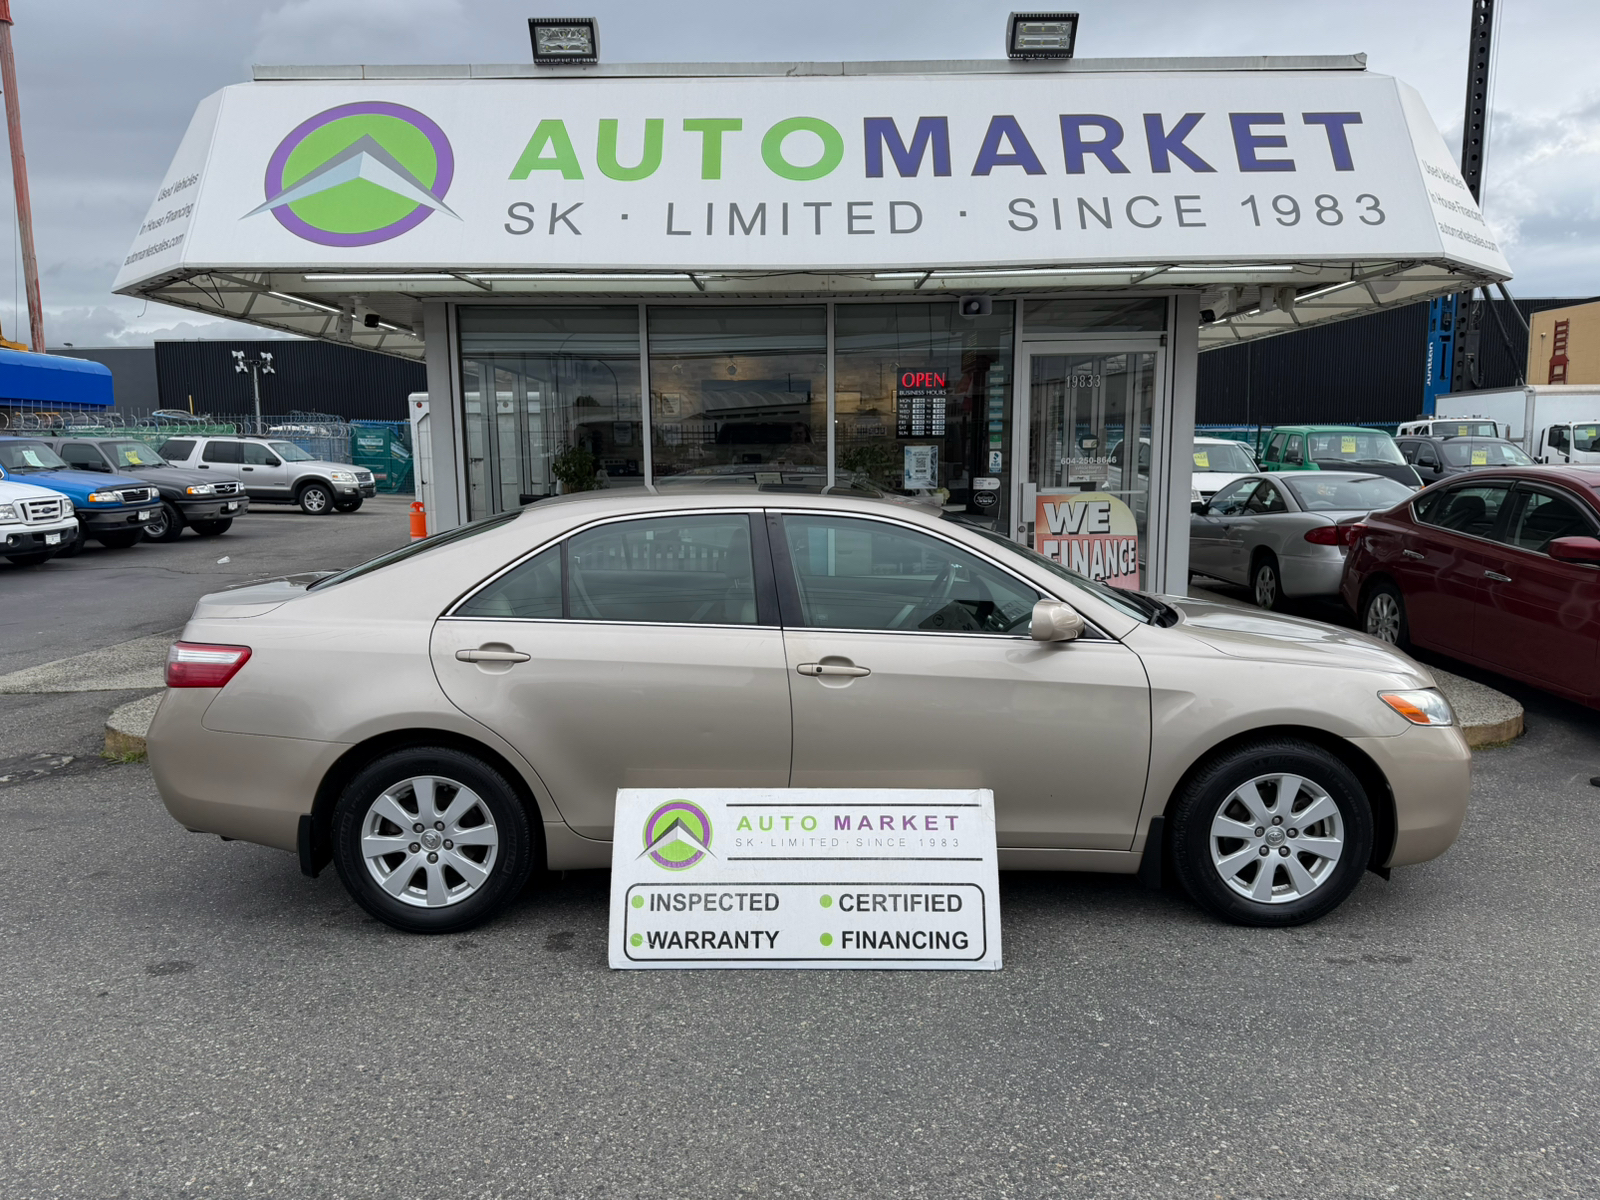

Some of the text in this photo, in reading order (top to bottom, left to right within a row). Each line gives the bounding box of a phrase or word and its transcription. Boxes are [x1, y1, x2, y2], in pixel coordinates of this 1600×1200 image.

[504, 193, 1386, 235] SK LIMITED SINCE 1983
[901, 371, 946, 388] OPEN
[1065, 374, 1101, 389] 19833
[1042, 501, 1110, 535] WE
[1043, 538, 1137, 581] FINANCE
[736, 815, 959, 831] AUTO MARKET
[735, 838, 960, 847] SK LIMITED SINCE 1983
[649, 893, 780, 912] INSPECTED
[838, 893, 963, 913] CERTIFIED
[646, 930, 780, 950] WARRANTY
[841, 930, 969, 950] FINANCING
